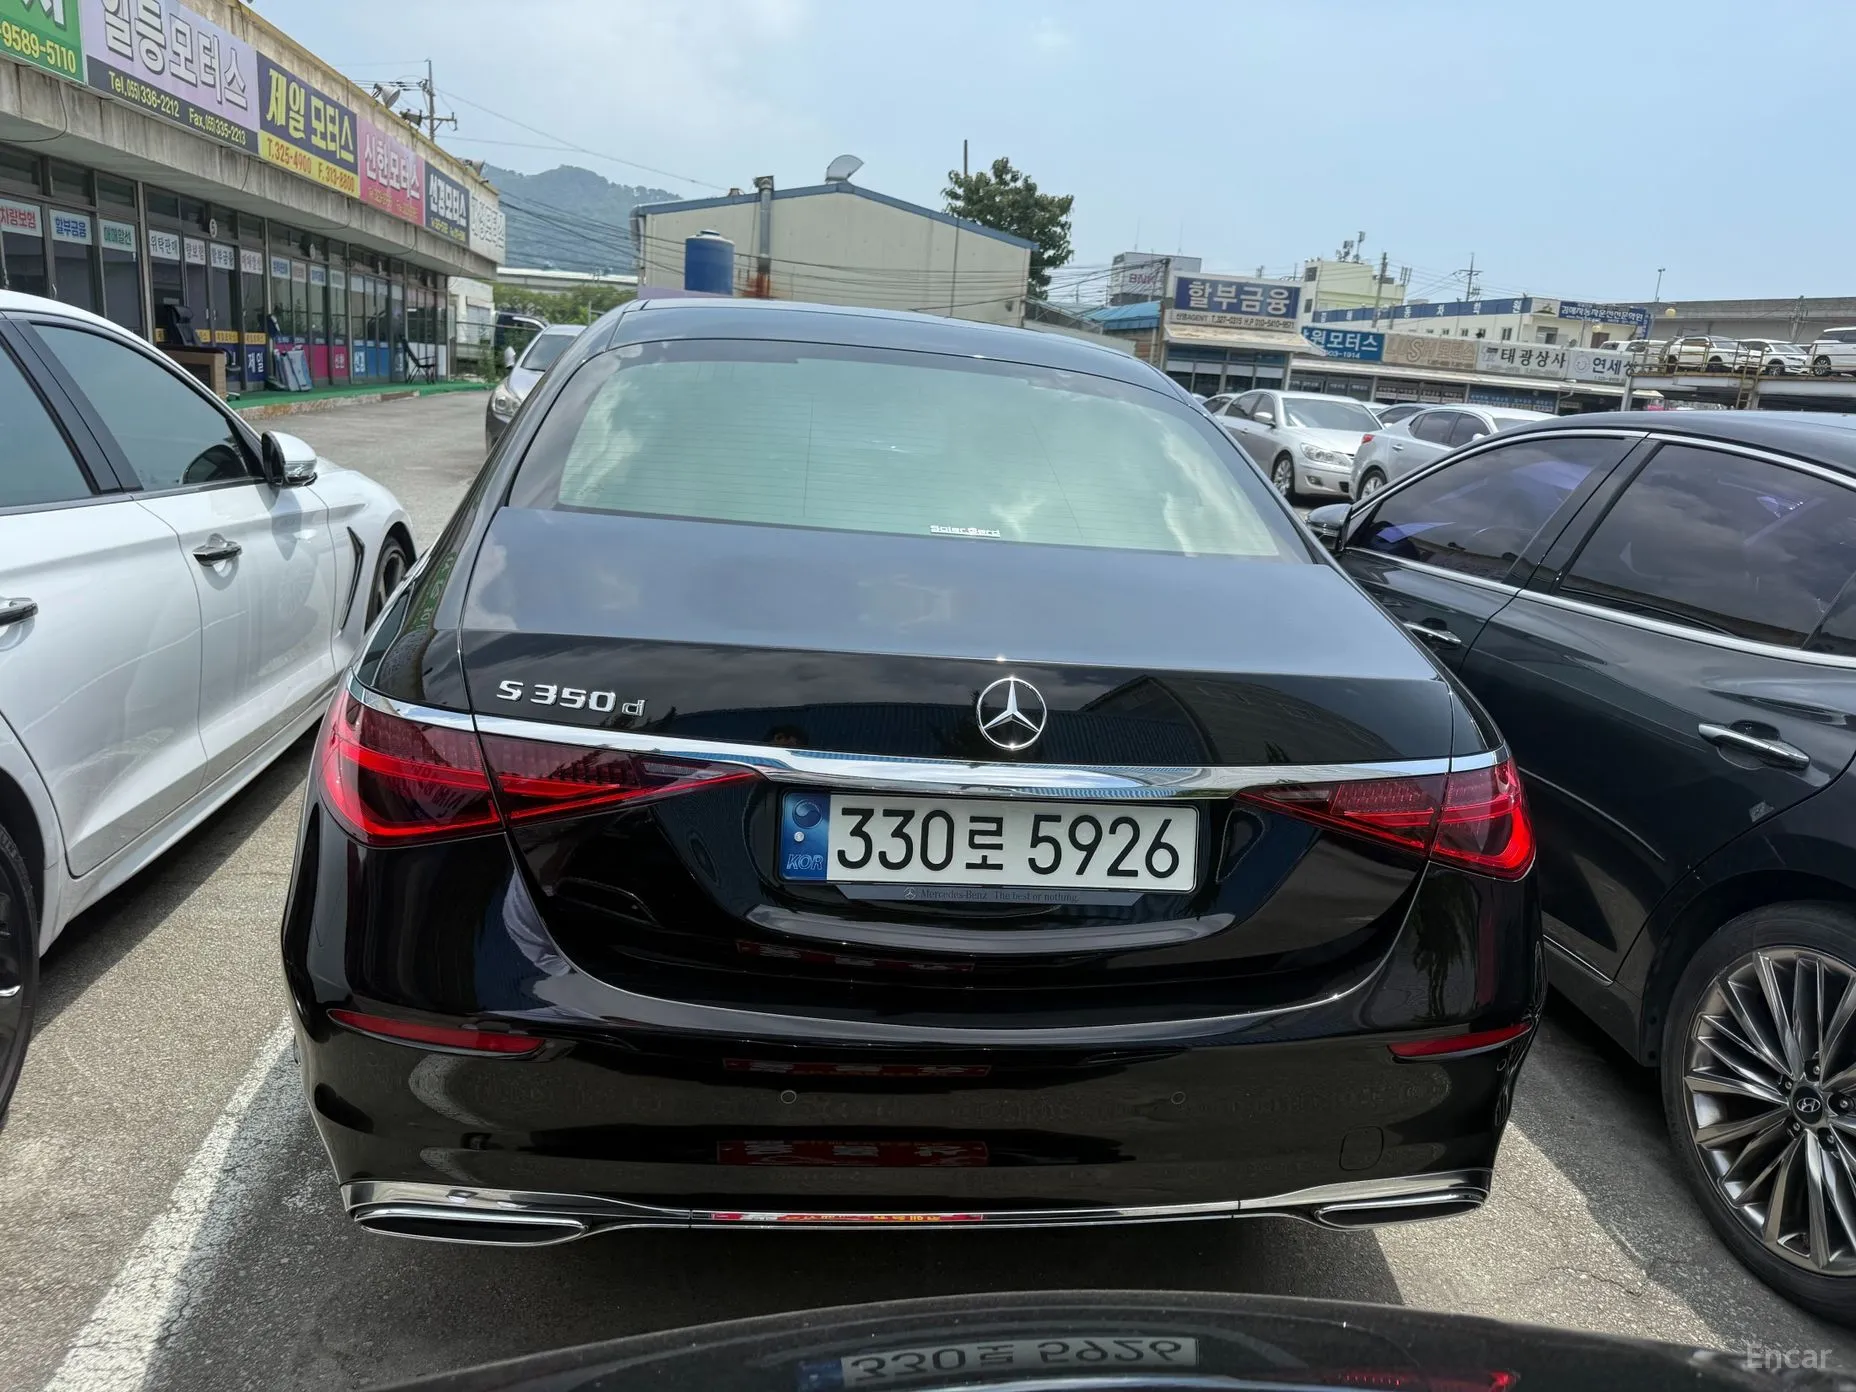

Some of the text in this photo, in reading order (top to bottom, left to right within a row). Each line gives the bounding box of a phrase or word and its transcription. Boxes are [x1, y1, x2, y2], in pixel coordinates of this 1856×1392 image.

[104, 0, 248, 110] 일등모터스
[266, 68, 354, 164] 제일 모터스
[364, 133, 420, 200] 신한모터스
[55, 215, 87, 238] 할부금융
[1188, 280, 1289, 315] 할부금융
[1500, 347, 1566, 369] 태광상사
[496, 680, 646, 717] S 350 d
[837, 807, 1180, 879] 330로 5926
[786, 854, 824, 871] KOR
[920, 888, 987, 900] Mercedes-Benz
[995, 890, 1011, 900] The
